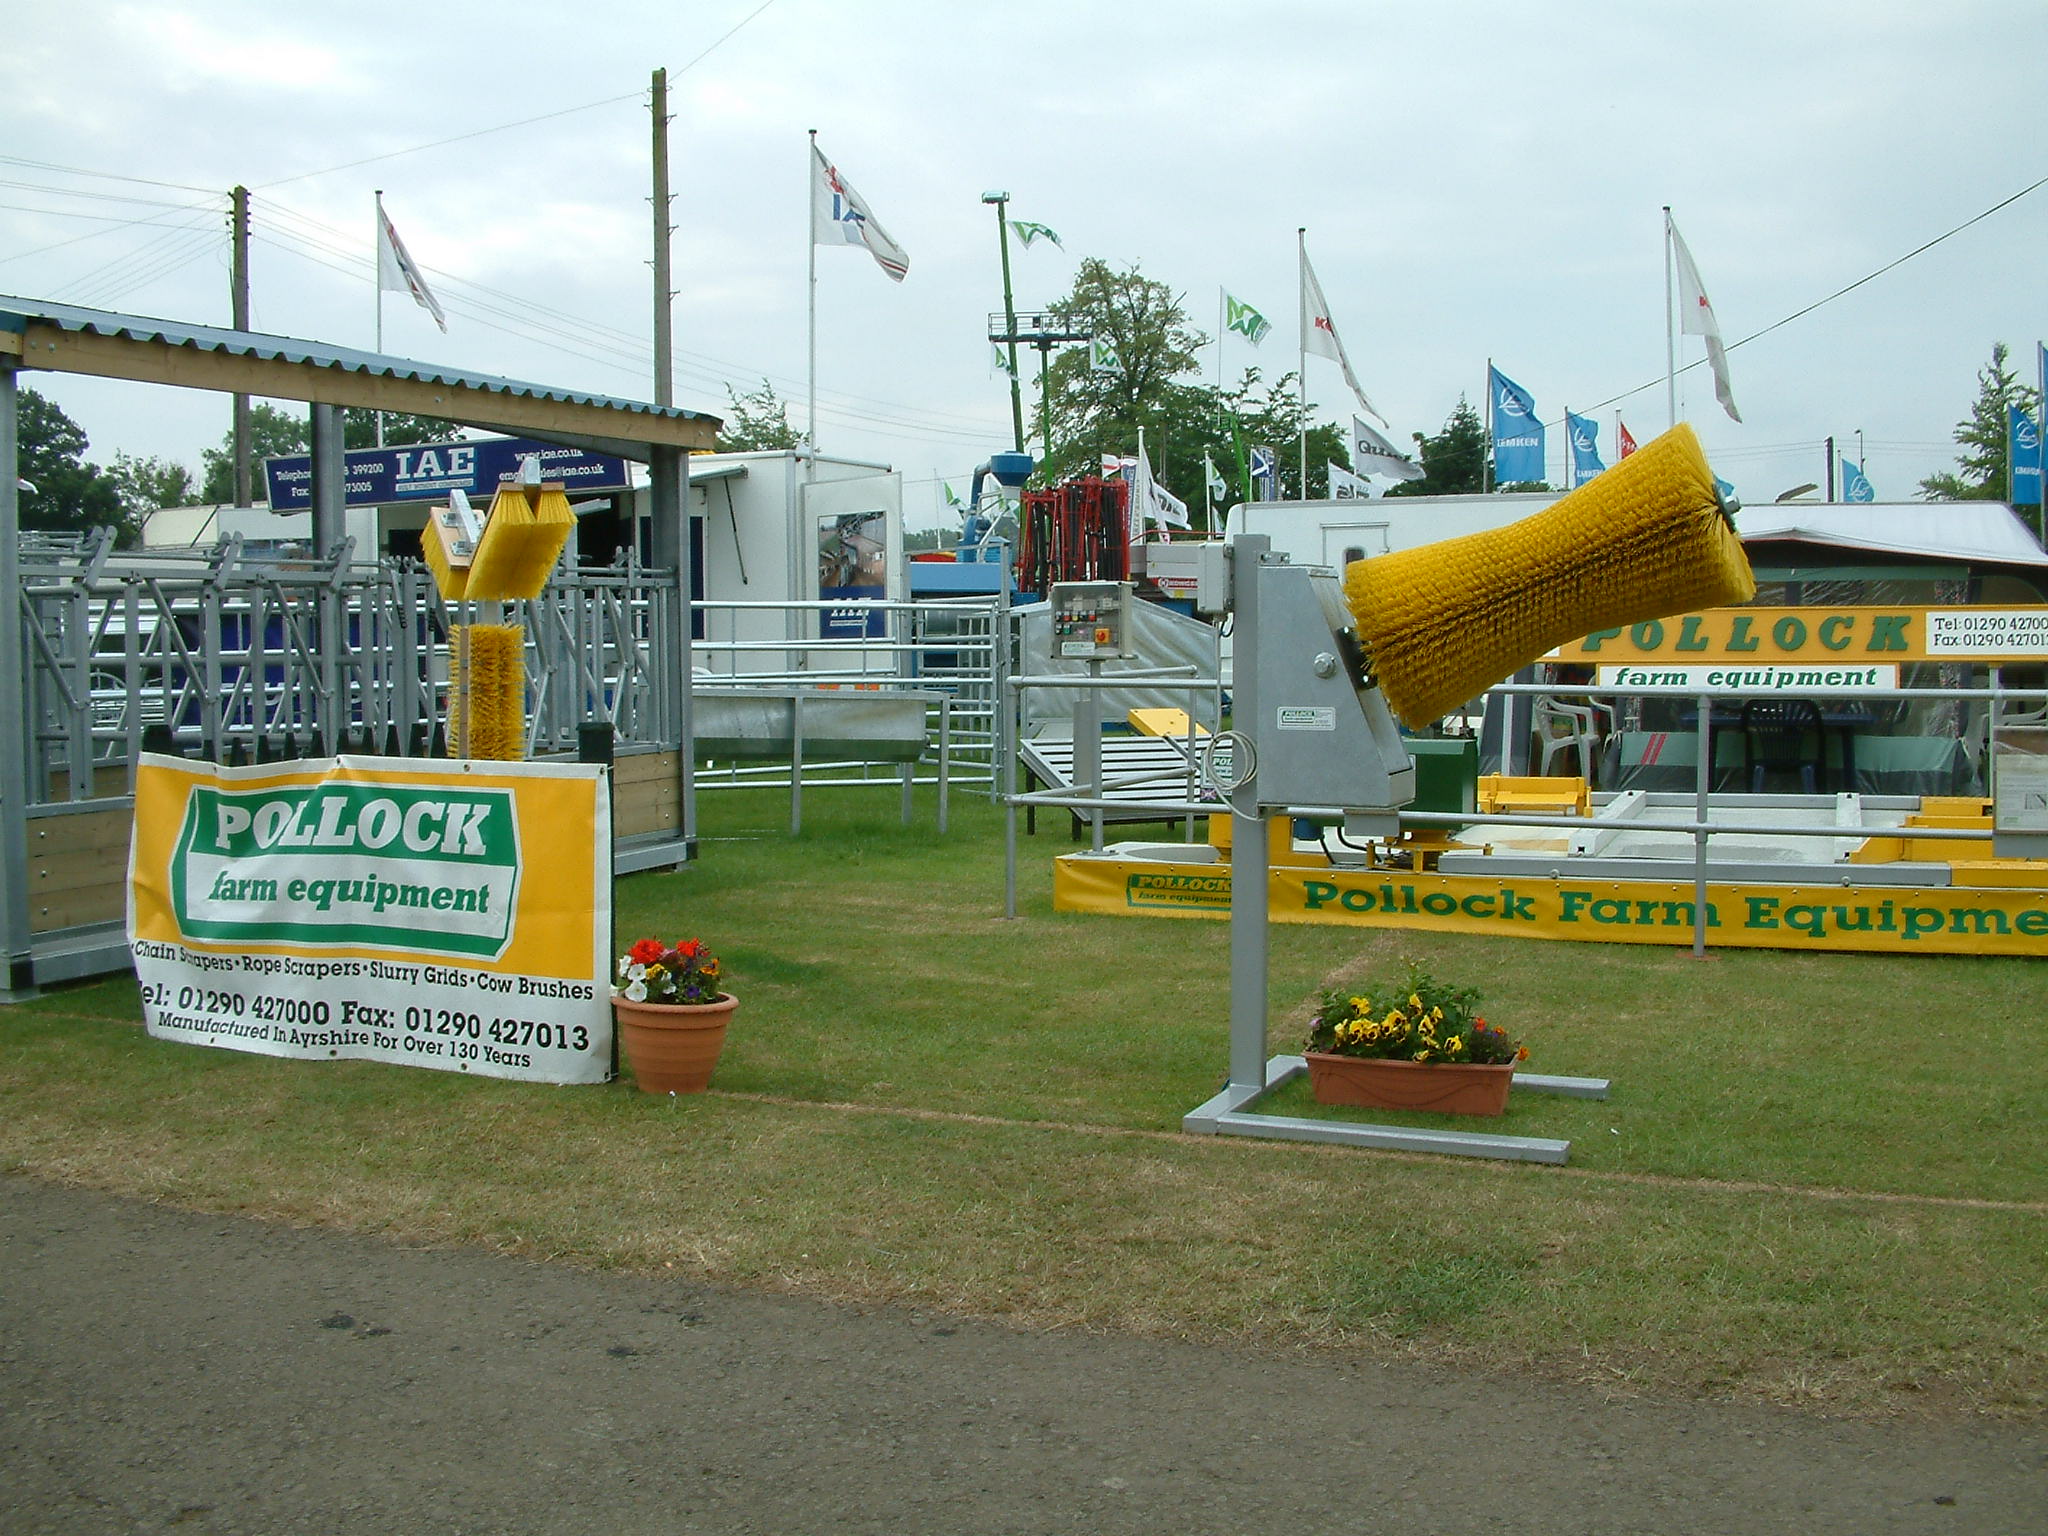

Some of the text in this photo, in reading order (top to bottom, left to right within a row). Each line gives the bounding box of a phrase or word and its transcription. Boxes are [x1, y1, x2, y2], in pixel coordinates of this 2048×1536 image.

[352, 463, 384, 475] 399200
[395, 447, 475, 480] IAE
[1581, 615, 1912, 652] POLLOCK
[1963, 633, 2004, 647] 01290
[1964, 617, 2006, 631] 01290
[1614, 666, 1877, 689] farm equipment
[215, 797, 492, 856] POLLOCK
[209, 871, 490, 913] farm equipment
[1138, 876, 1232, 892] POLLOCK
[1303, 880, 1536, 921] Pollock
[1558, 890, 1721, 930] Farm
[135, 940, 176, 961] Chain
[241, 955, 281, 975] Rope
[284, 957, 361, 980] Scrapers
[370, 961, 419, 985] Slurry
[424, 966, 468, 988] Grids
[477, 972, 513, 993] Cow
[519, 977, 593, 1000] Brushes
[178, 986, 245, 1016] 01290
[252, 995, 330, 1026] 427000
[341, 1000, 395, 1029] Fax:
[405, 1006, 481, 1039] 01290
[488, 1018, 590, 1051] 427013
[158, 1011, 531, 1068] Manufactured In Ayrshire For Over 130 Years
